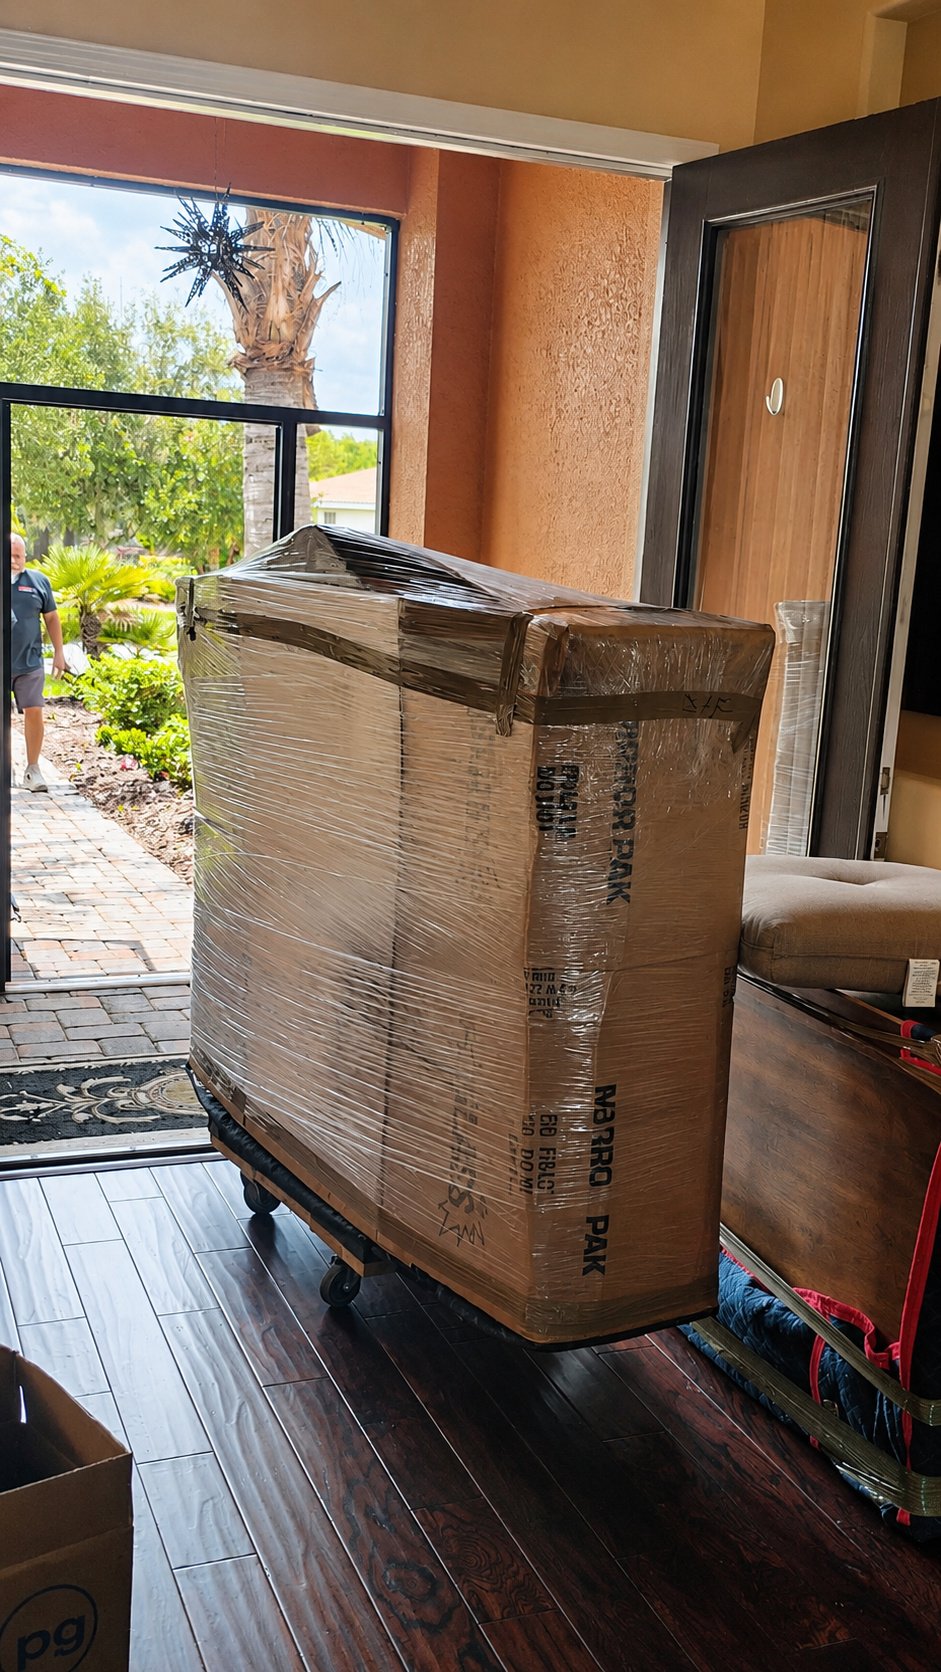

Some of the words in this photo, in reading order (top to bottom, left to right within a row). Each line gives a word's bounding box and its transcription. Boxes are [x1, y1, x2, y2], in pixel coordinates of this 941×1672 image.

[607, 838, 634, 905] PAK
[582, 1214, 609, 1276] PAK
[17, 1615, 85, 1671] pg
